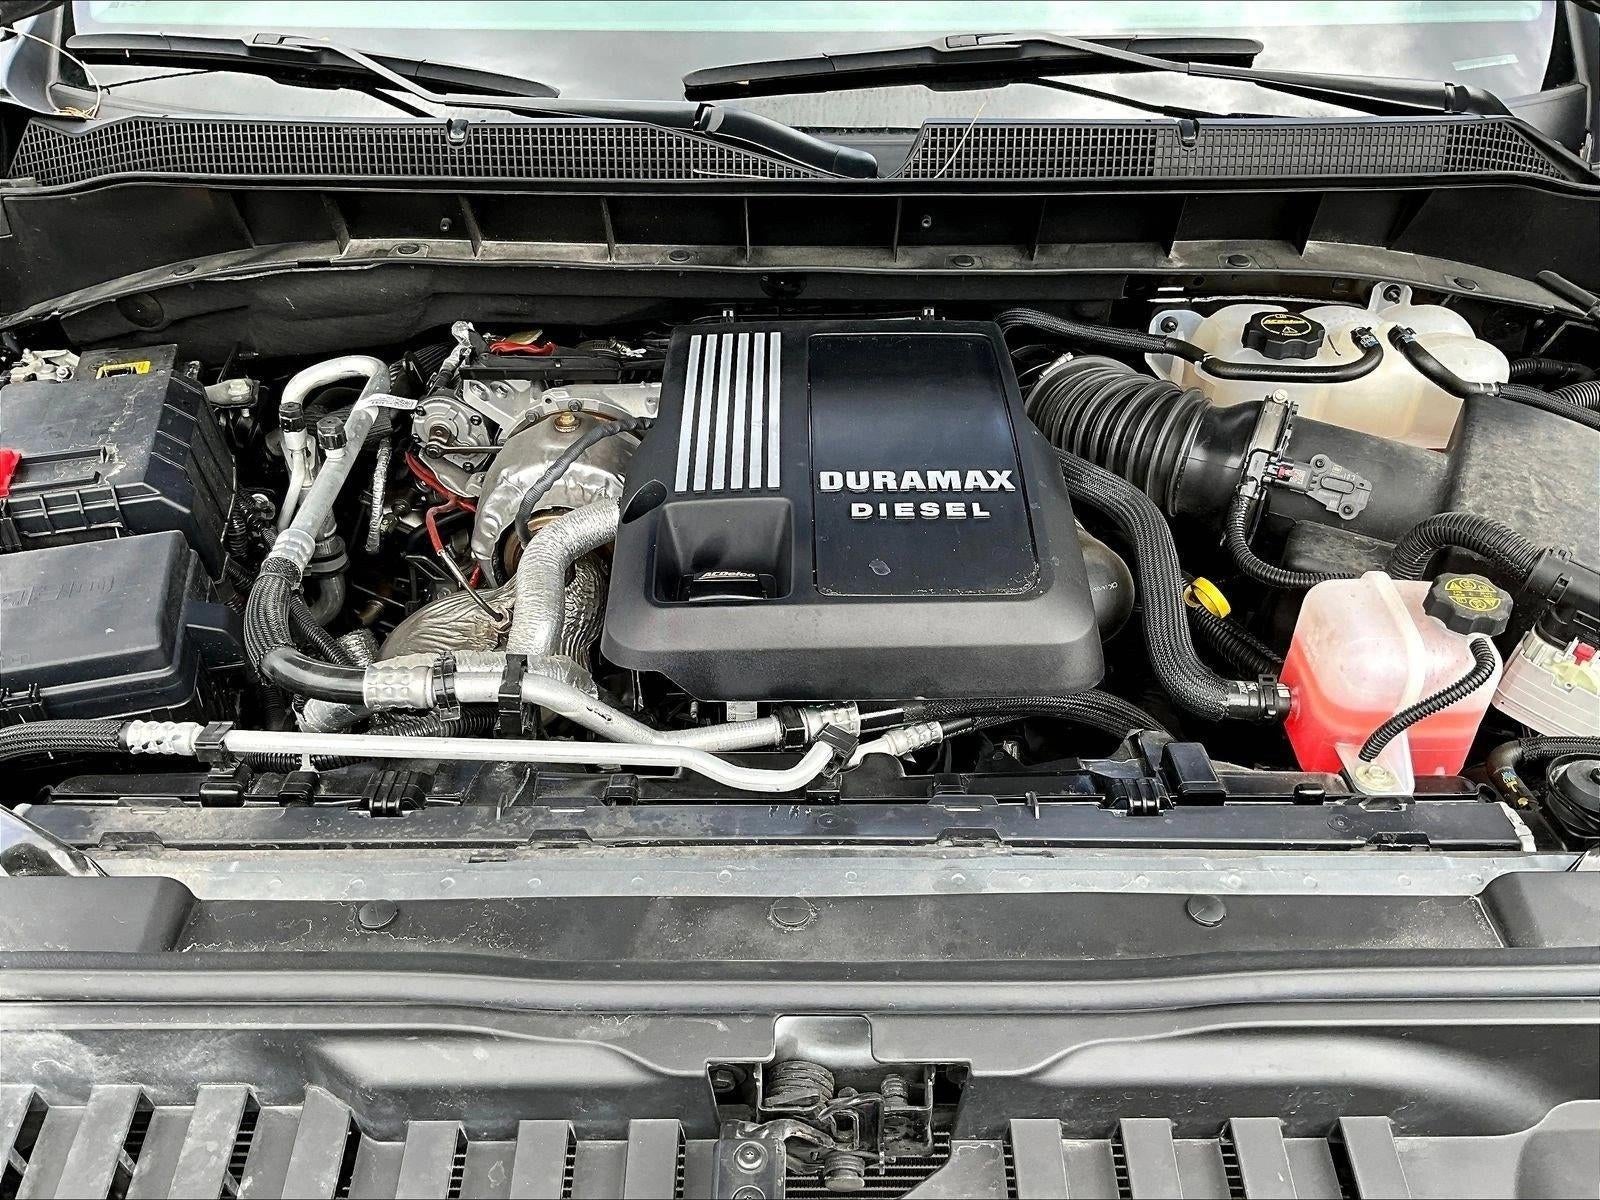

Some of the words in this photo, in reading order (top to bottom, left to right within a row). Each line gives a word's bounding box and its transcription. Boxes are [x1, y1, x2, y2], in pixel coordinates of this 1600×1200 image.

[819, 470, 1016, 492] DURAMAX
[850, 502, 991, 520] DIESEL
[700, 571, 757, 579] ACDelco
